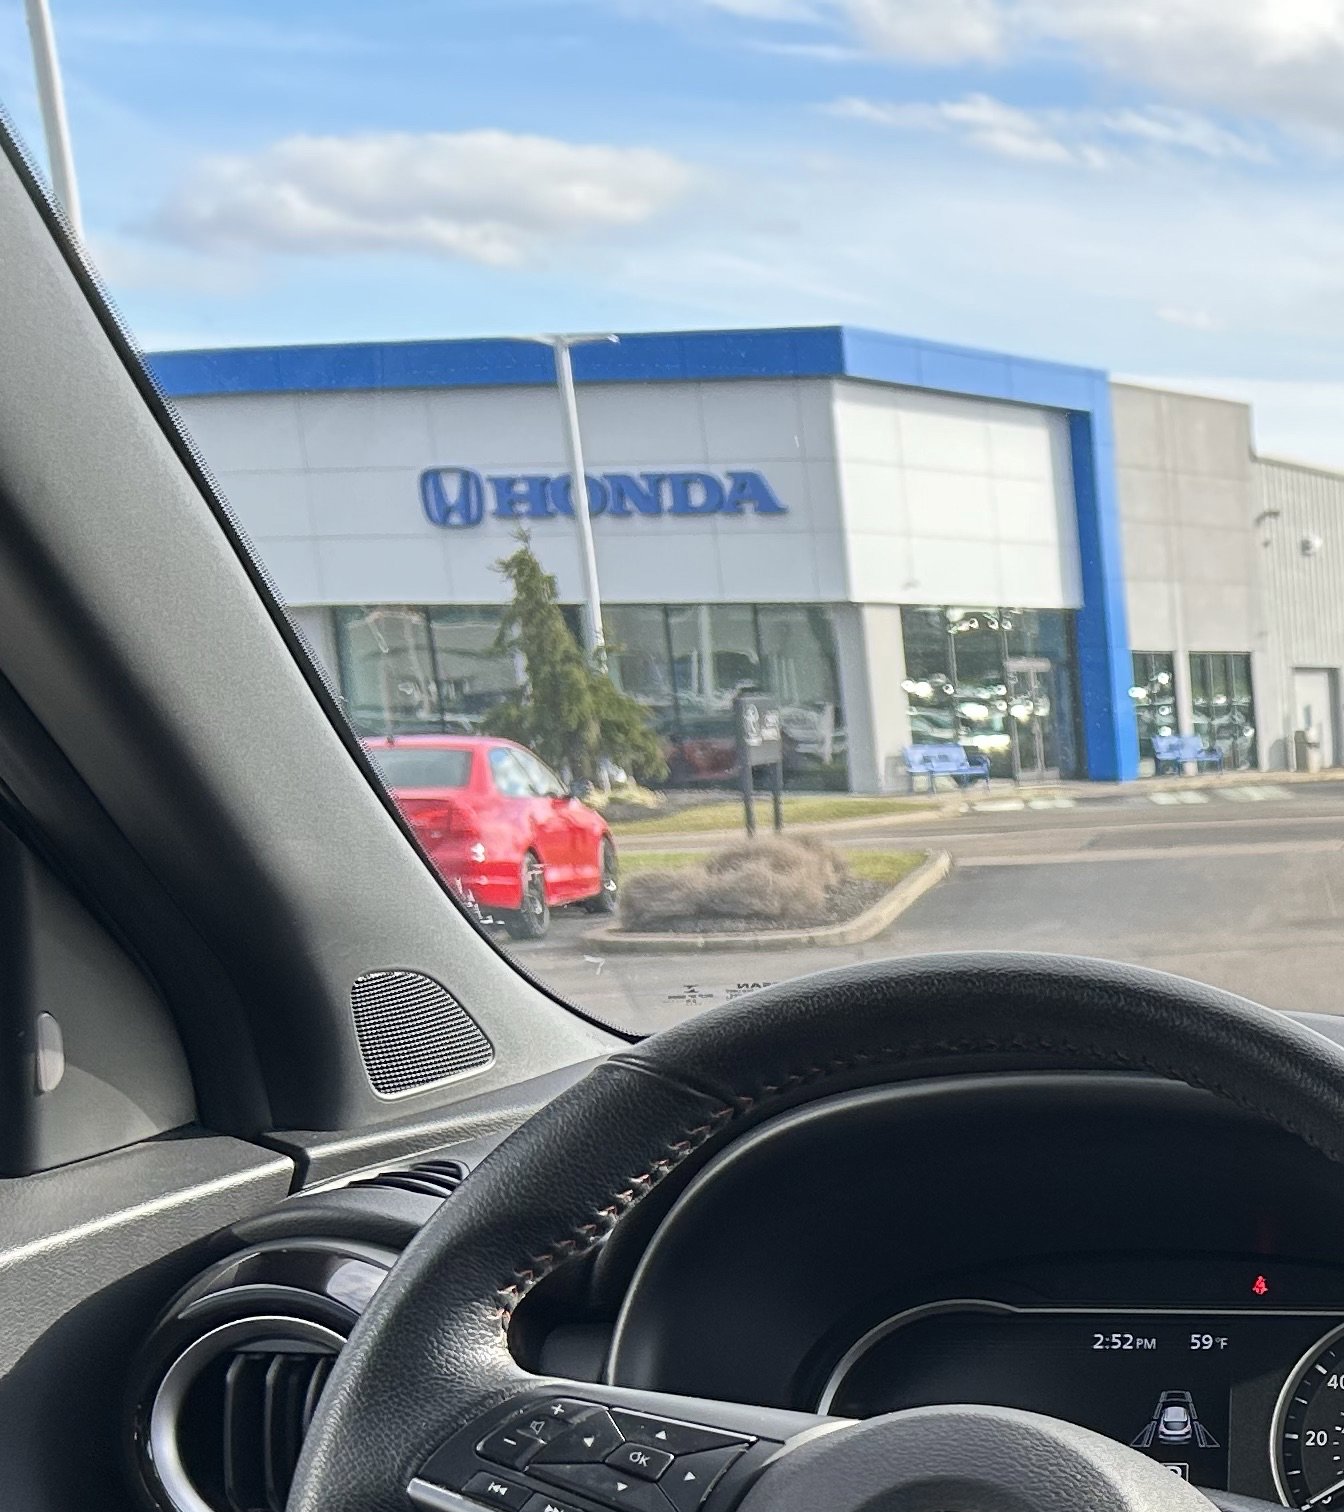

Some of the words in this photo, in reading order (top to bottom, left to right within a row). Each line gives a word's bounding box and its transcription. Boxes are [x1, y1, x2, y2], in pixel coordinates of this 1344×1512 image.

[488, 471, 788, 515] HONDA
[1305, 1431, 1328, 1446] 20
[629, 1451, 651, 1467] OK
